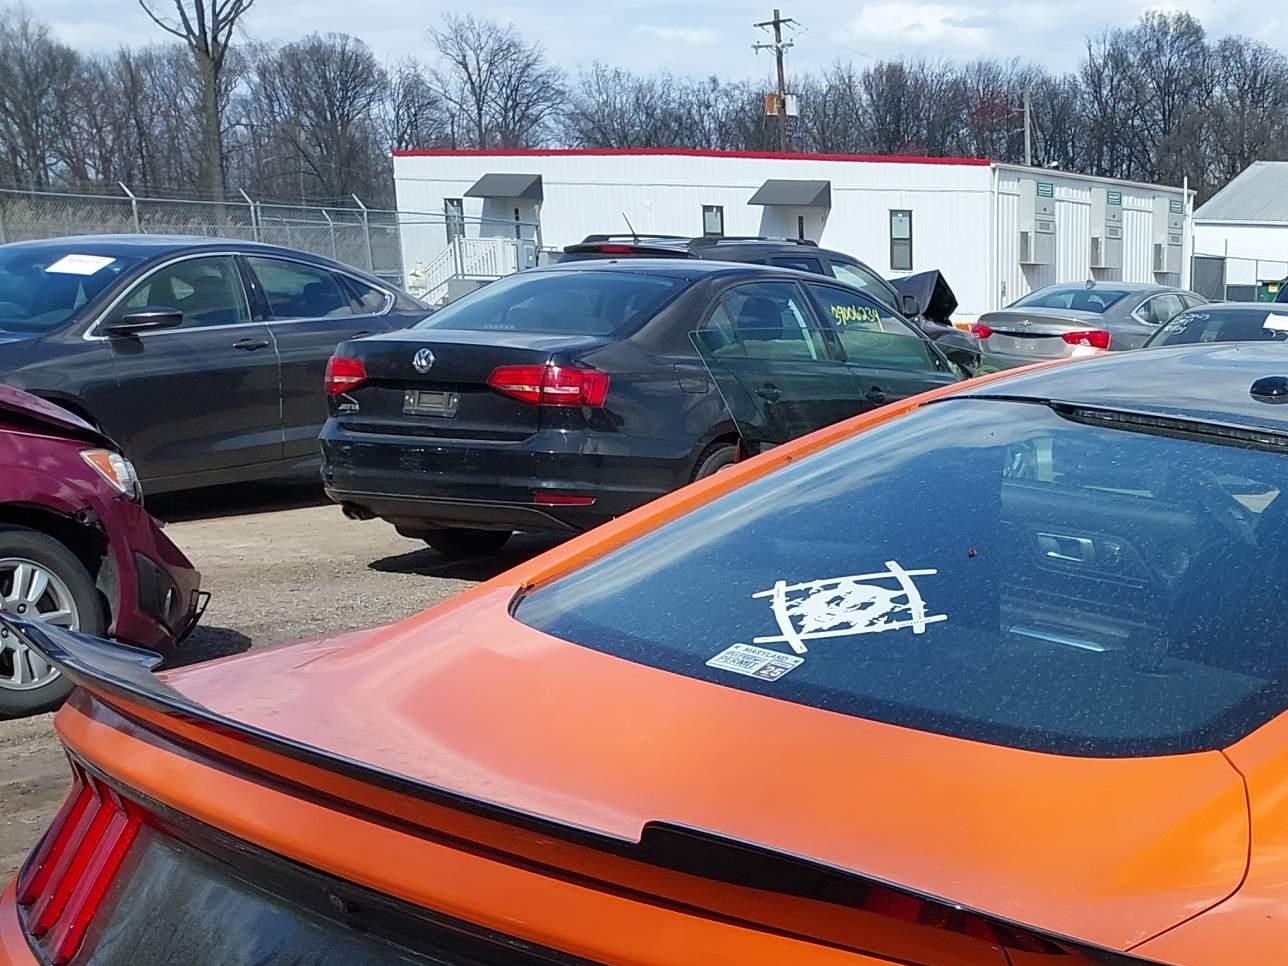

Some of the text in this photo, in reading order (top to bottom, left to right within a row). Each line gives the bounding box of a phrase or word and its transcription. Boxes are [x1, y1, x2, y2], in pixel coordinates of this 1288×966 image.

[742, 647, 789, 661] MARYLAND
[718, 654, 760, 670] PERMIT
[759, 665, 785, 678] 25
